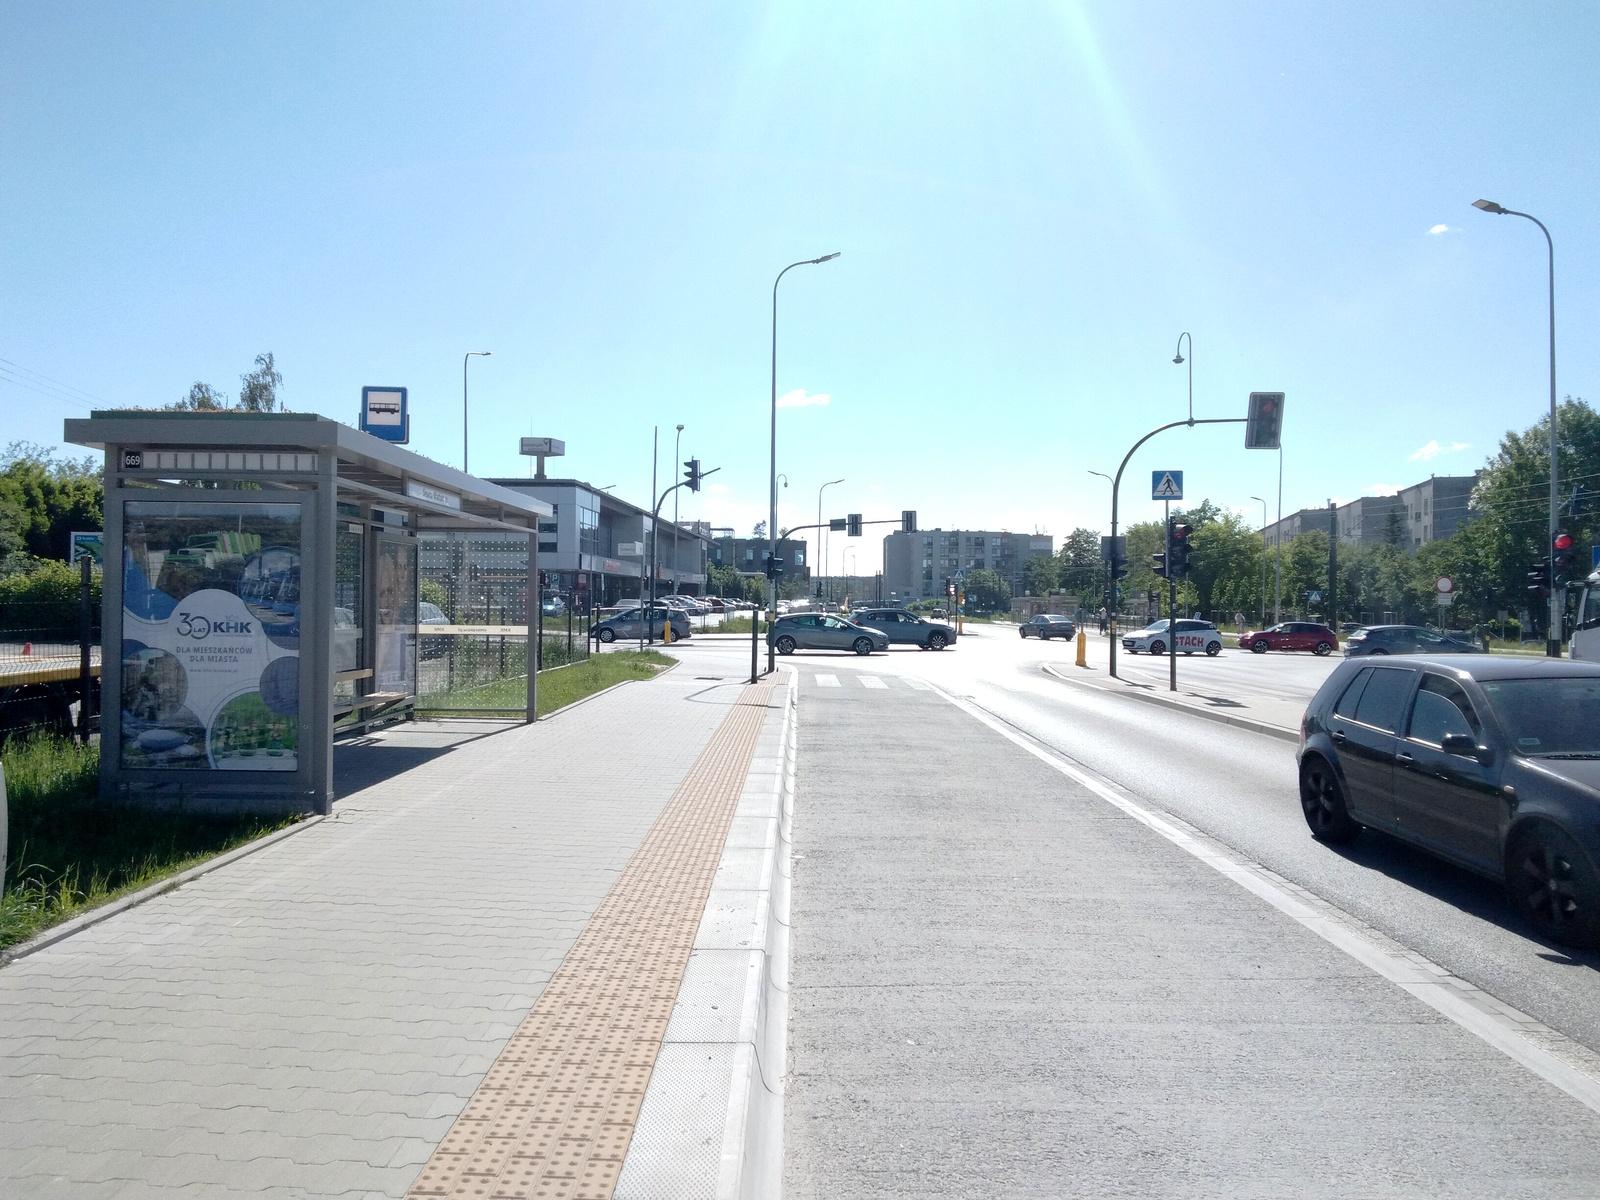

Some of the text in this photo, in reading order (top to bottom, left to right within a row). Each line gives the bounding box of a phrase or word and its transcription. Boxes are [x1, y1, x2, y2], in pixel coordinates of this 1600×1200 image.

[126, 455, 140, 465] 669
[176, 612, 252, 640] 30 KHK
[176, 645, 253, 654] DLA MIESZKAŃCÓW
[189, 655, 239, 663] DLA MIASTA
